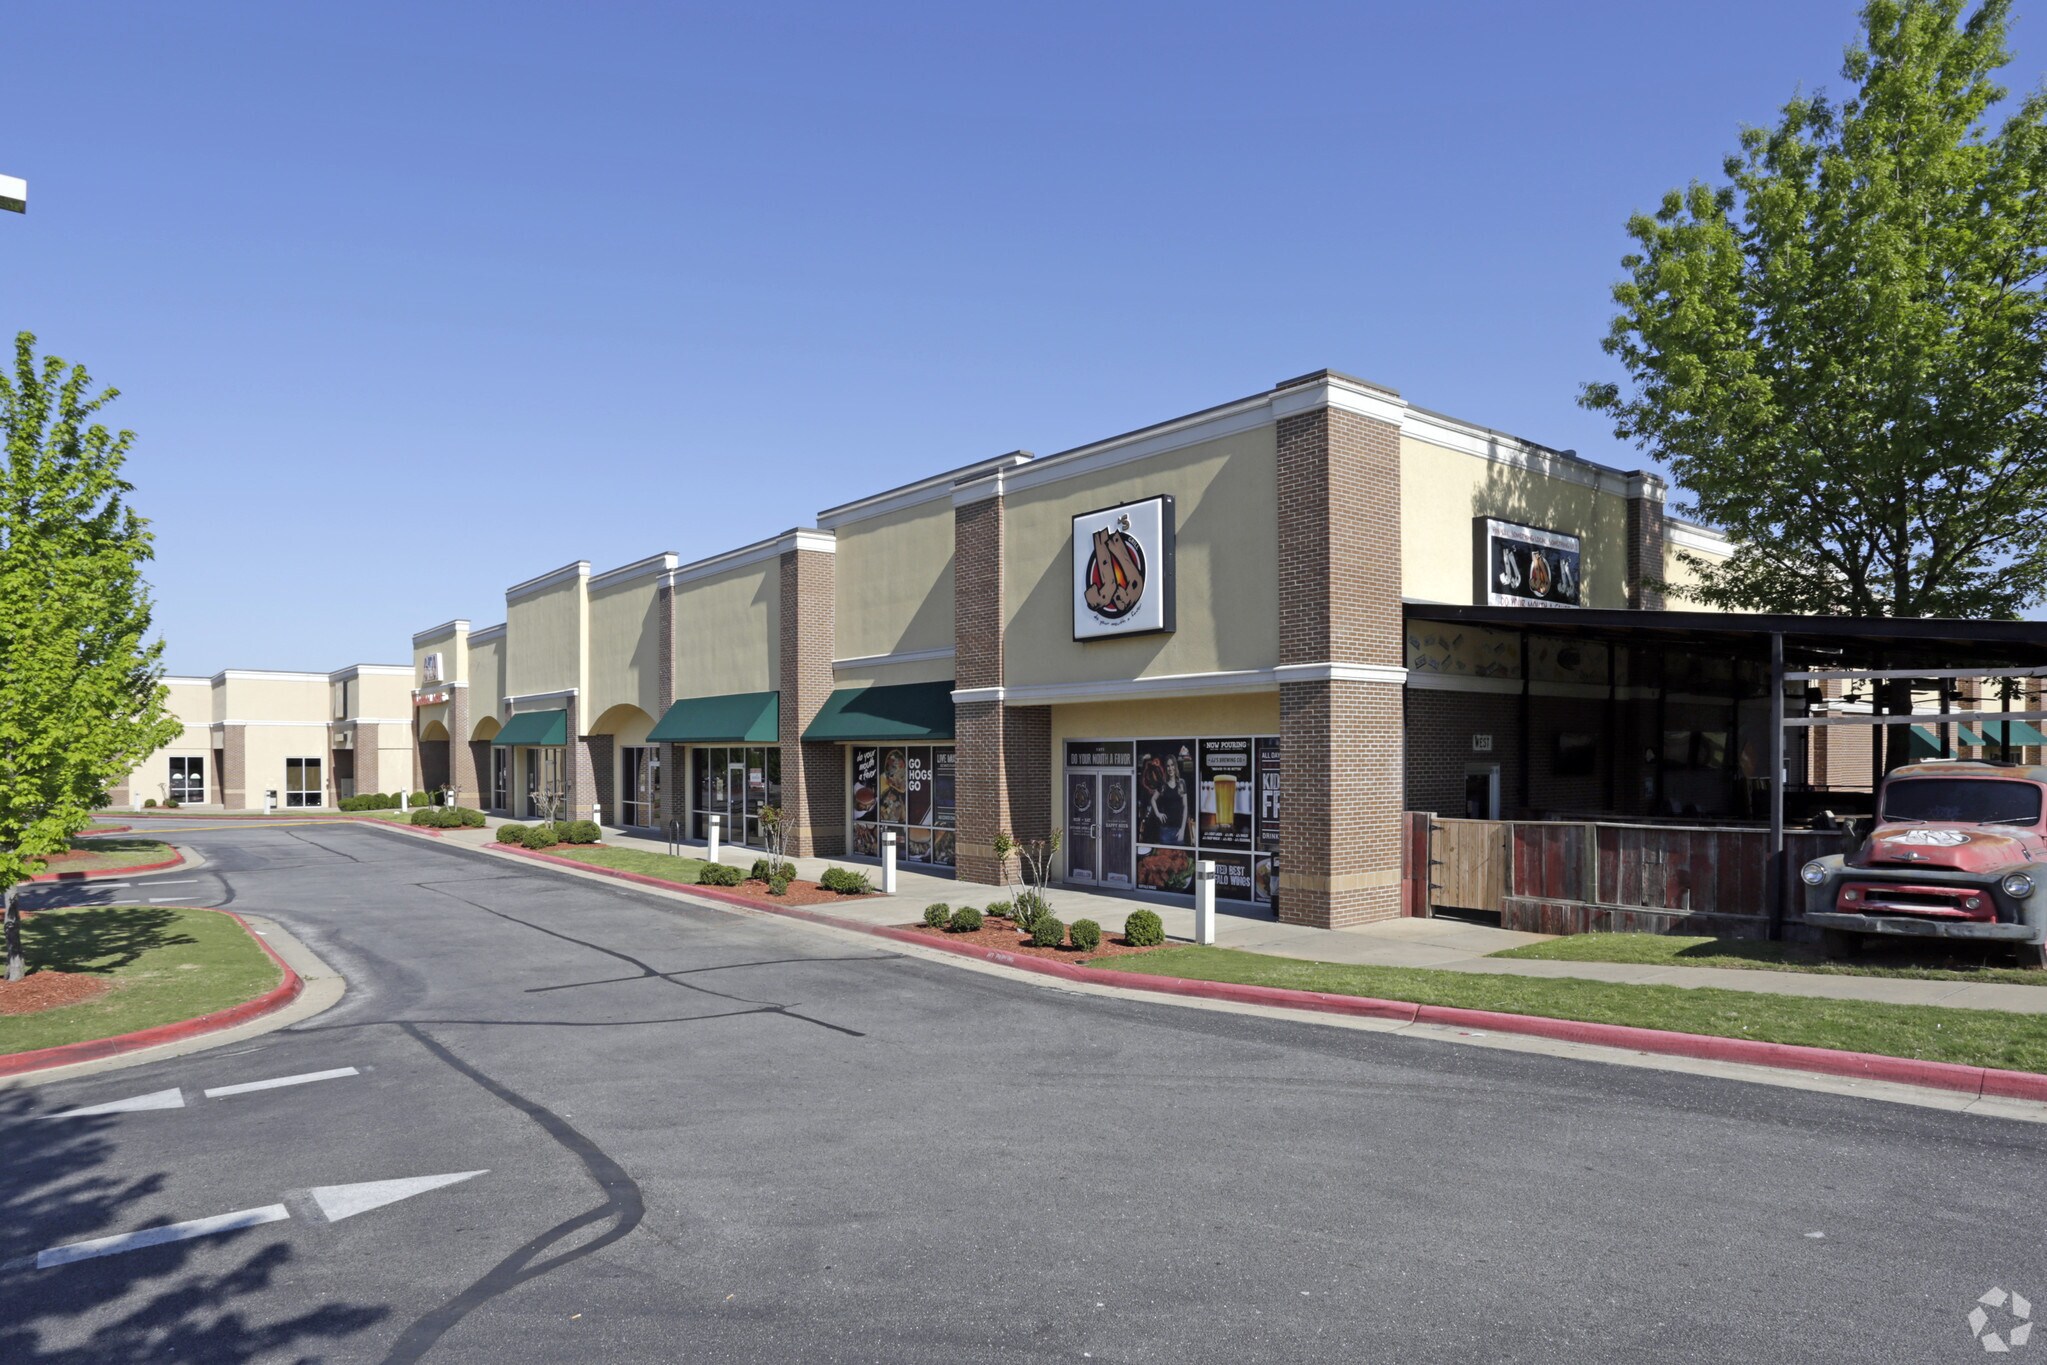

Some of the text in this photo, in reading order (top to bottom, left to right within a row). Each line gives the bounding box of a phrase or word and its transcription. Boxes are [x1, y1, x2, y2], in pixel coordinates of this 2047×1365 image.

[1128, 536, 1139, 550] GRILL
[1475, 736, 1491, 748] WEST
[856, 749, 877, 762] do your
[937, 754, 947, 764] LIVE
[1079, 753, 1091, 765] YOUR
[1092, 753, 1109, 765] MOUTH
[1114, 753, 1131, 765] FAVOR
[859, 757, 875, 771] mouth
[908, 758, 921, 769] GO
[863, 769, 877, 781] favor
[909, 769, 932, 780] HOGS
[908, 781, 921, 791] GO
[1215, 864, 1245, 876] TED BEST
[1230, 875, 1251, 887] WINGS
